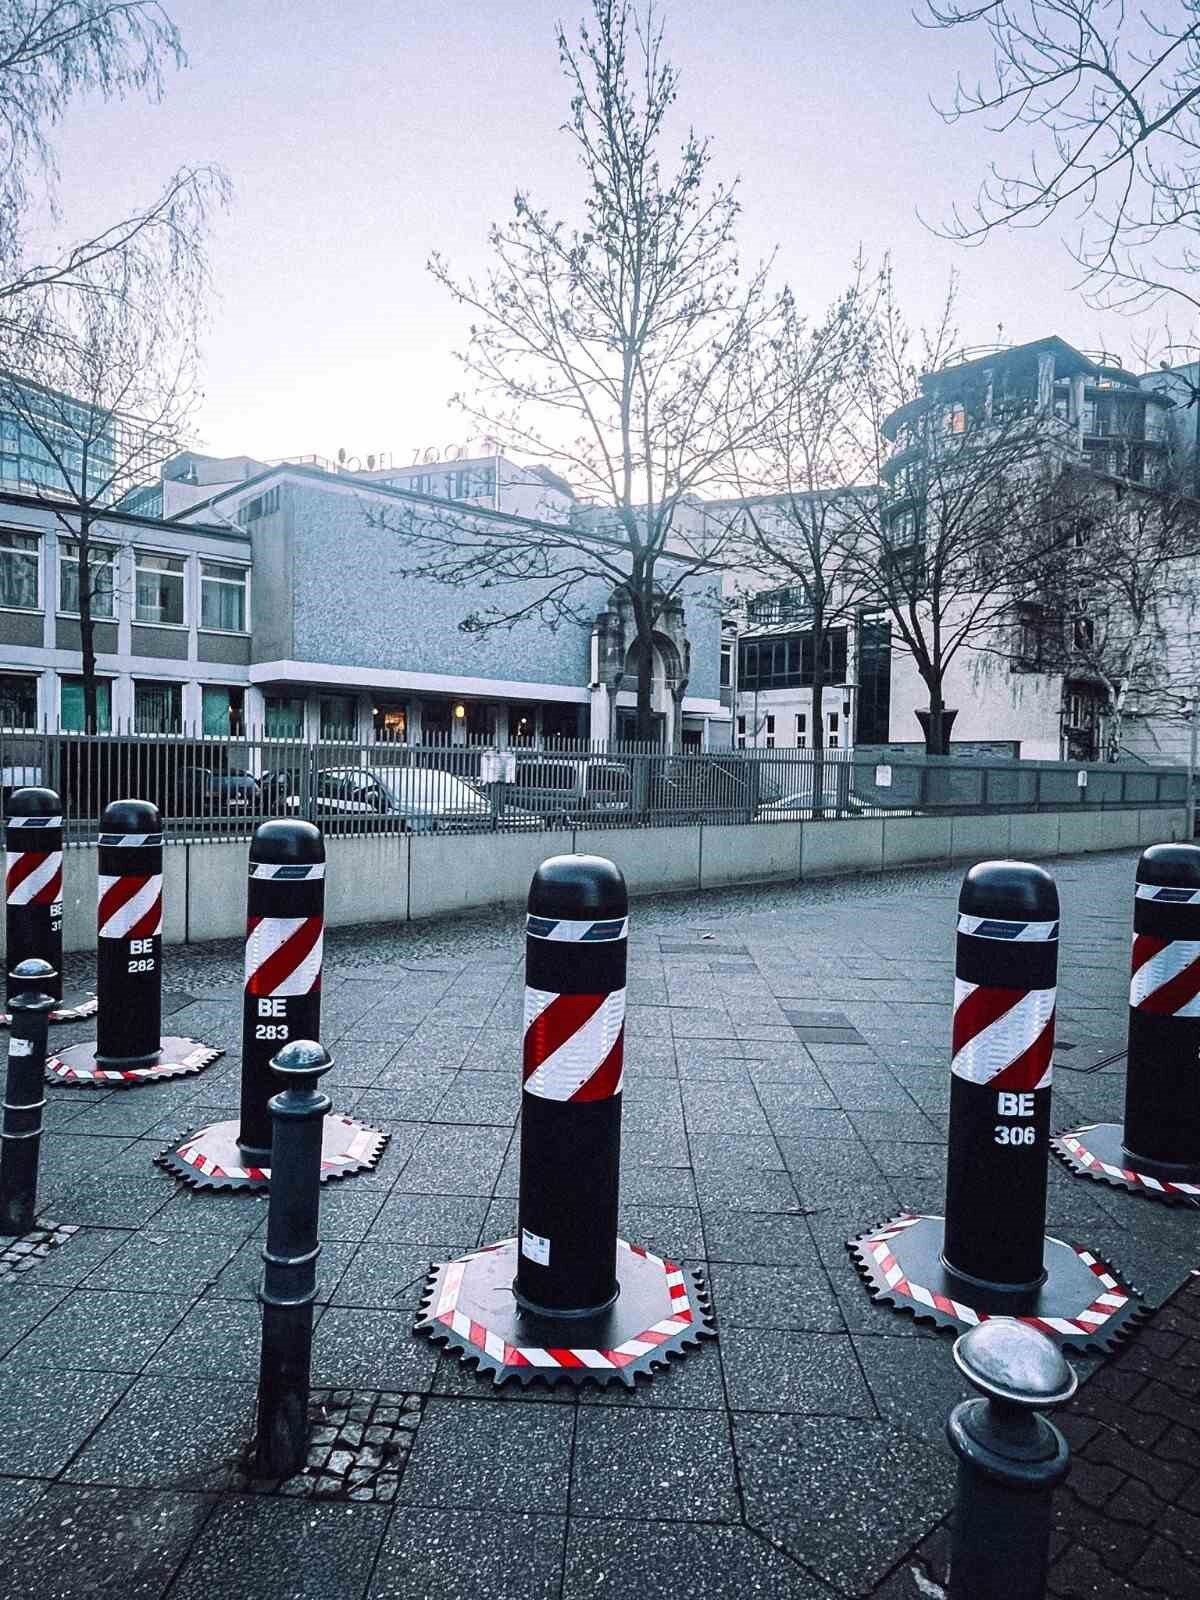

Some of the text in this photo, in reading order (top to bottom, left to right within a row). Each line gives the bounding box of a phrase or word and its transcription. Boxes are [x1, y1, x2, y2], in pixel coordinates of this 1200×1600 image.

[130, 938, 153, 955] BE
[128, 959, 155, 973] 282
[258, 998, 287, 1017] BE
[255, 1024, 289, 1040] 283
[998, 1092, 1035, 1117] BE
[994, 1125, 1036, 1145] 306
